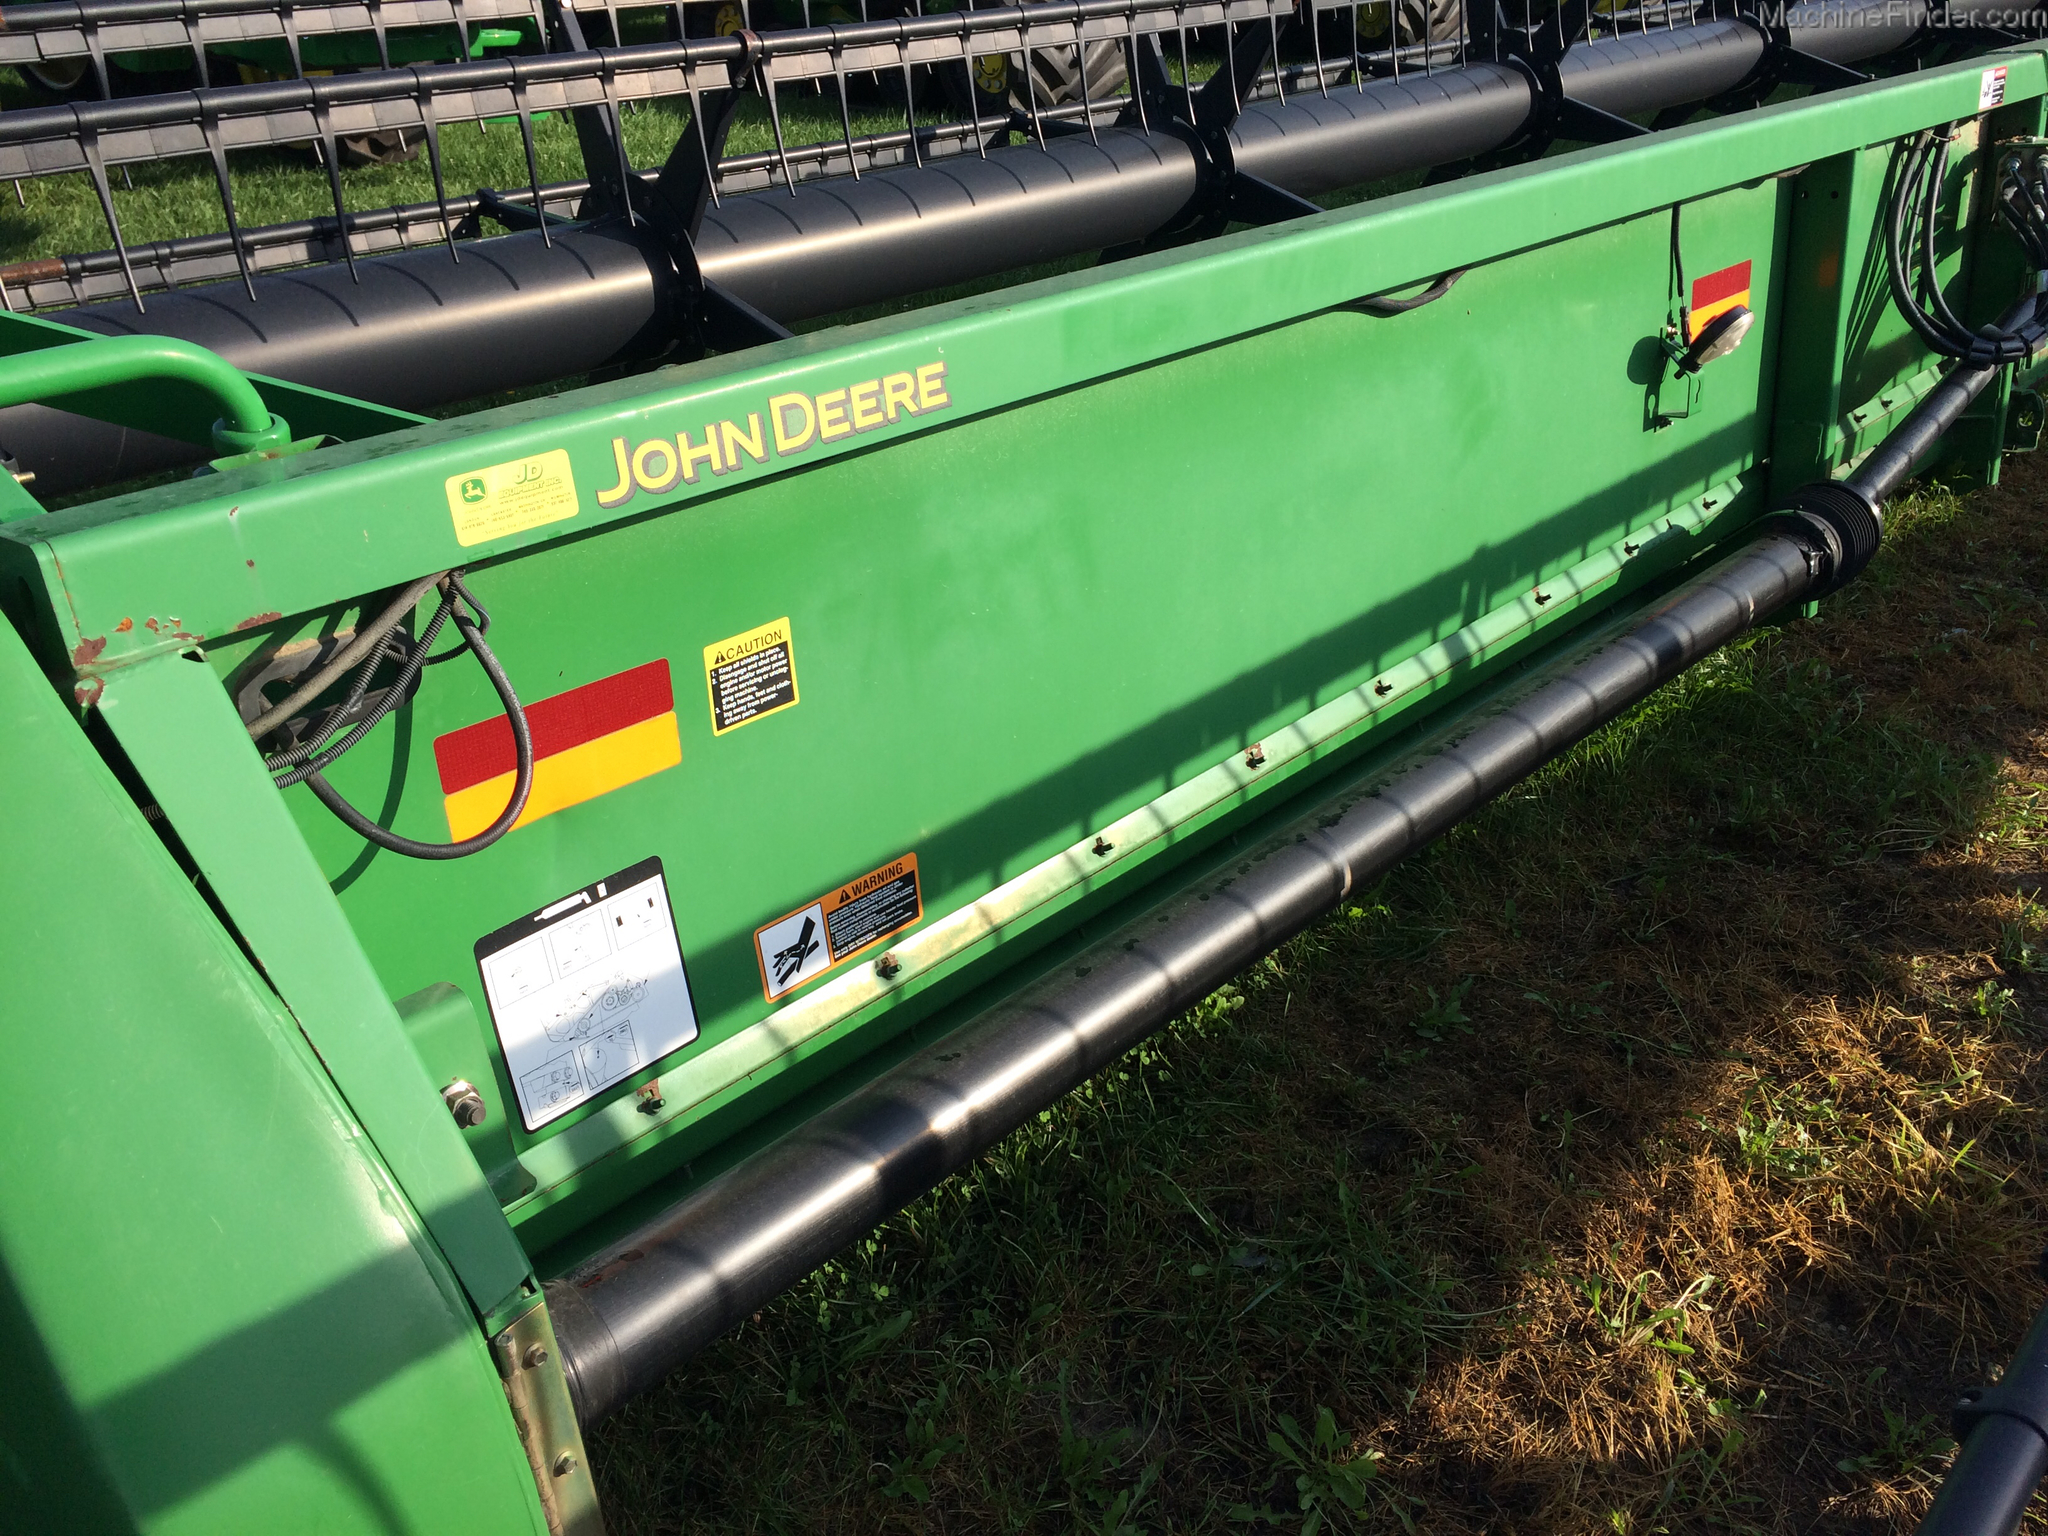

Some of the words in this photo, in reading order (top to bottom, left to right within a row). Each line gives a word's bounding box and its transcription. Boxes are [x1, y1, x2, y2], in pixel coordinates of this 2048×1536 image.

[595, 412, 771, 508] JOHN
[768, 361, 951, 457] DEERE
[499, 480, 545, 499] EQUIPMENT
[544, 475, 562, 487] INC.
[512, 461, 543, 485] JD
[726, 629, 782, 660] CAUTION
[851, 862, 903, 896] WARNING
